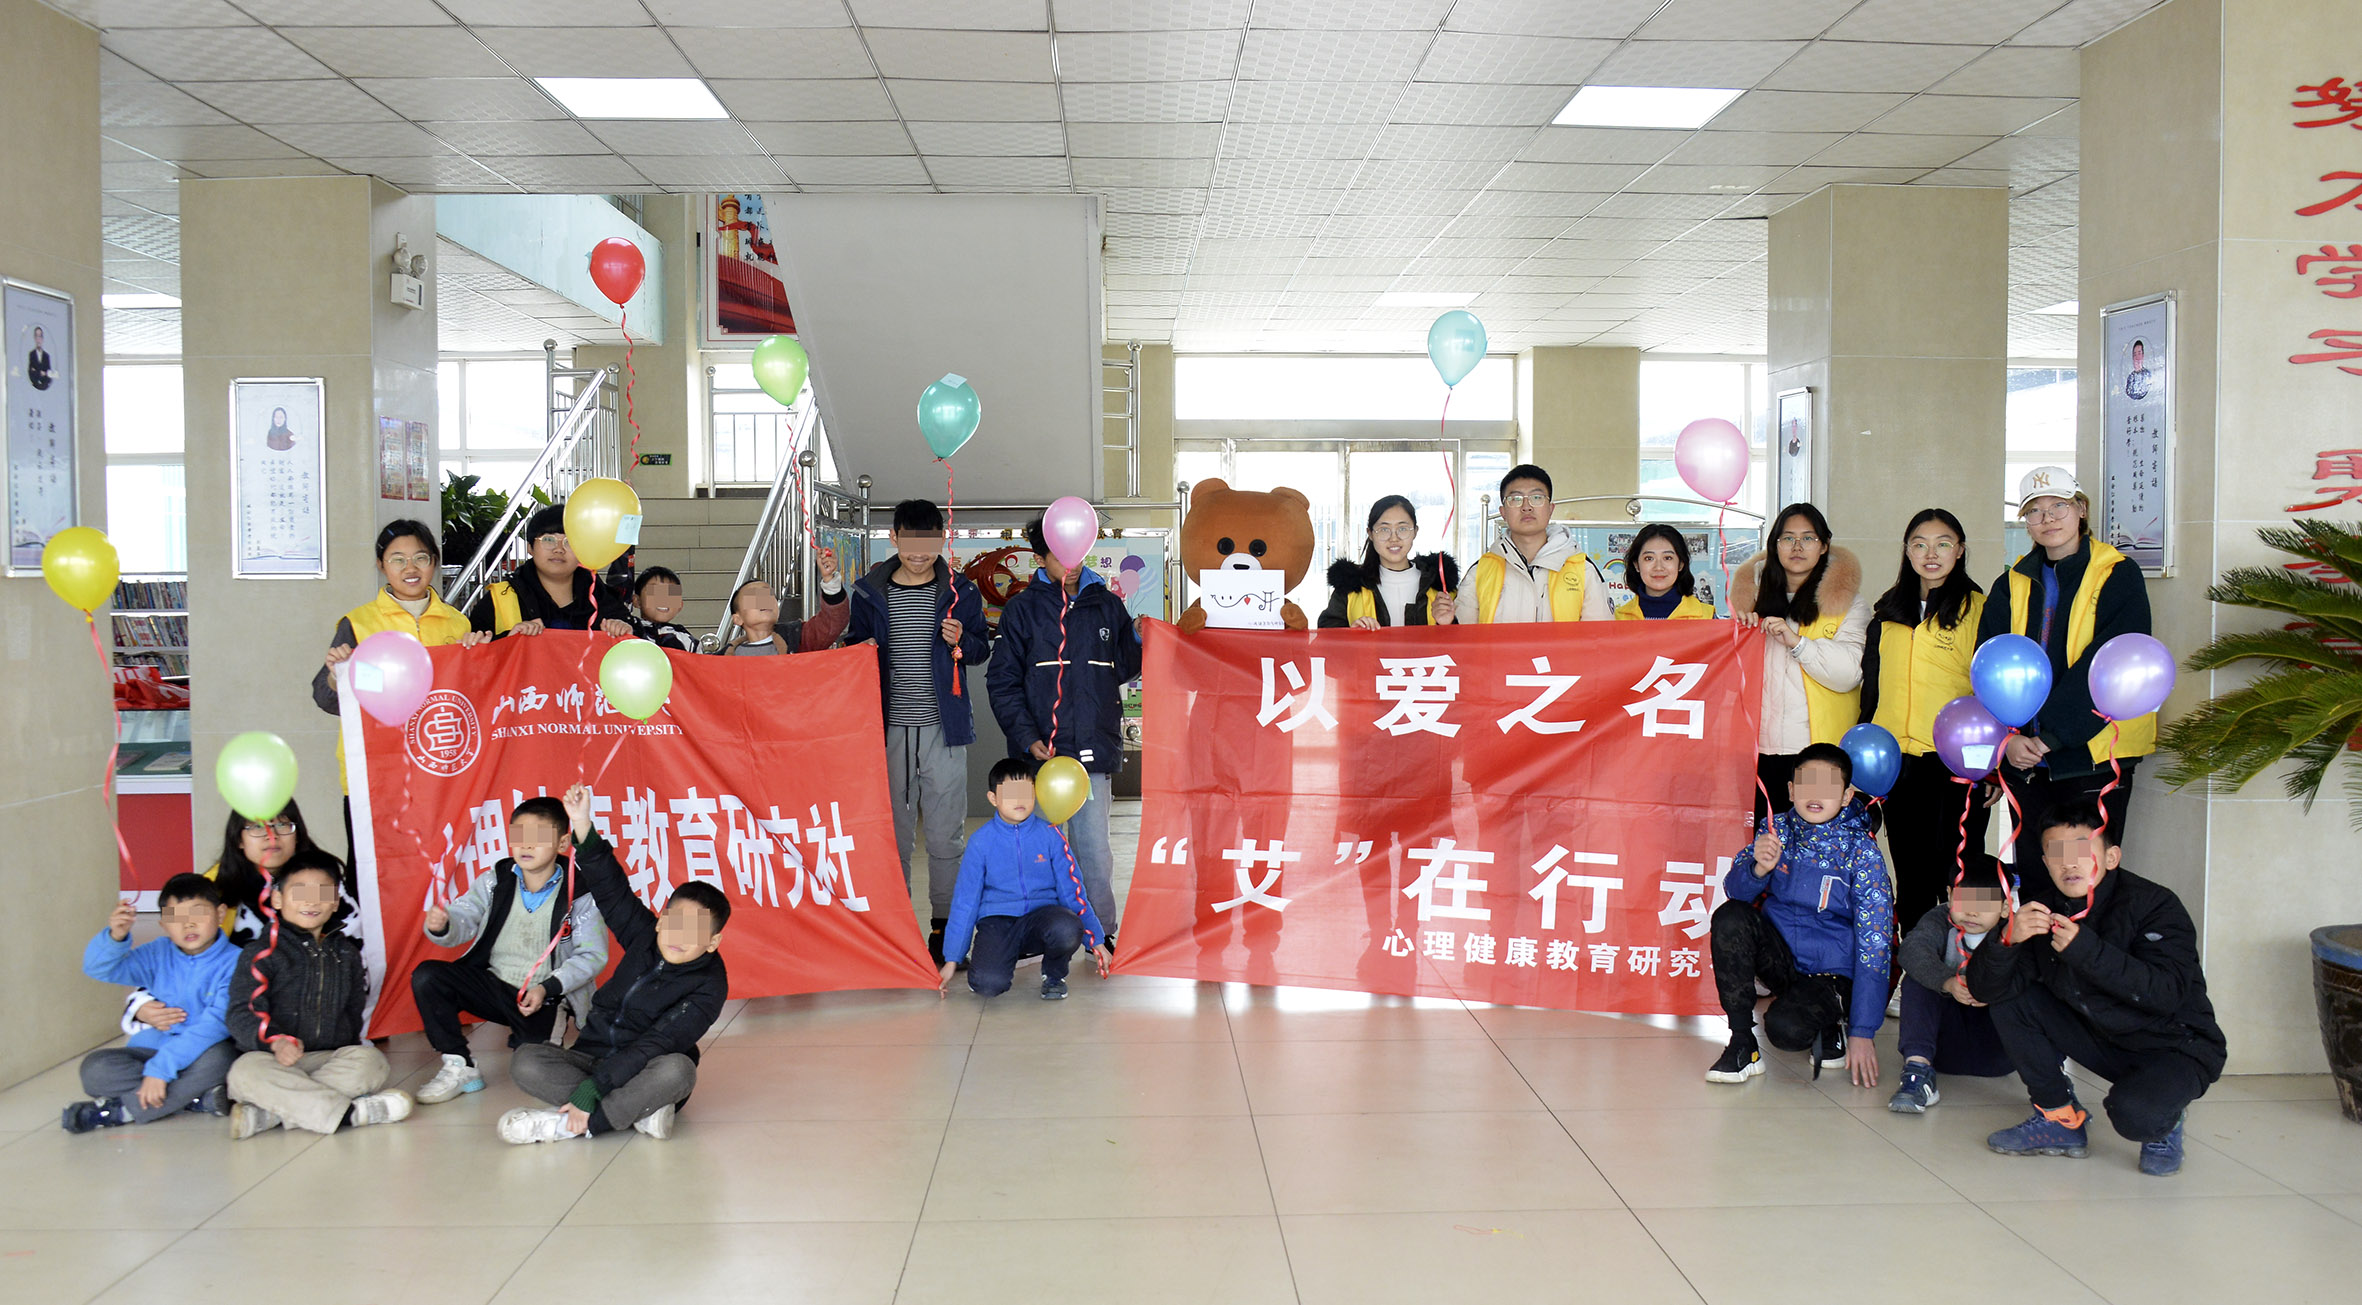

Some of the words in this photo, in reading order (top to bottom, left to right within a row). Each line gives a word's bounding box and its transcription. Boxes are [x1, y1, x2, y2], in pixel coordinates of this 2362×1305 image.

[2032, 471, 2050, 489] NY
[1255, 653, 1709, 740] 以爱之名
[491, 724, 535, 741] SHANXI
[537, 722, 601, 736] NORMAL
[604, 723, 684, 736] UNIVERSITY
[1382, 928, 1714, 978] 心理健康教育研究
